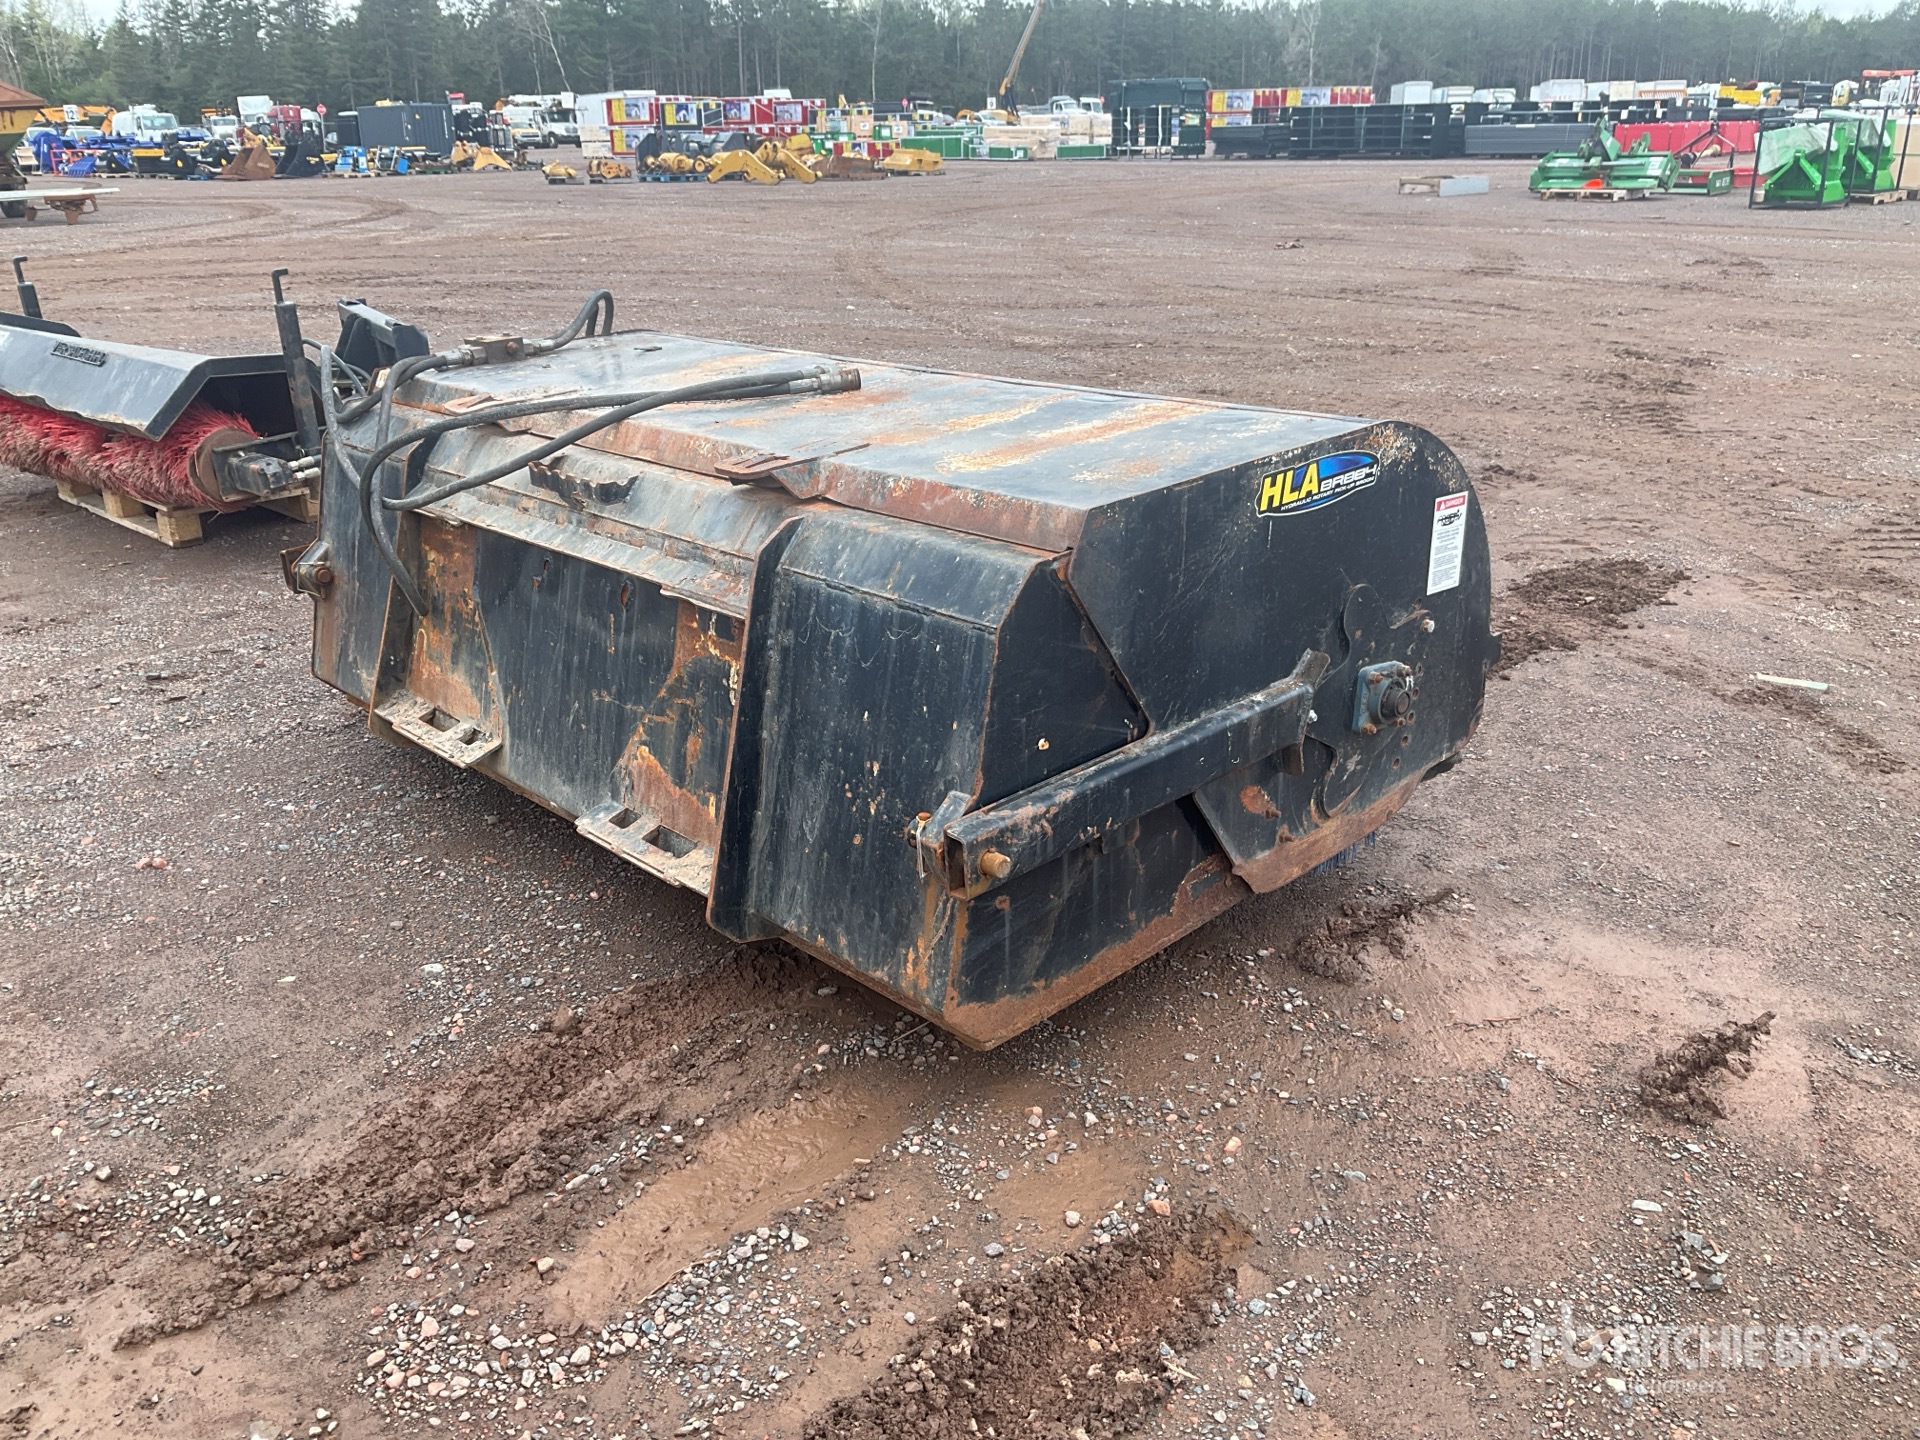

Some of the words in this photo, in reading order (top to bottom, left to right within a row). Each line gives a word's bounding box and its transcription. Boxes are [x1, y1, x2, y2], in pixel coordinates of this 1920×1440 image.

[66, 110, 76, 119] 12
[1260, 462, 1318, 511] HLA
[1281, 497, 1312, 511] HYDRAULIC
[1312, 489, 1334, 501] ROTARY
[1355, 475, 1375, 487] BROOM
